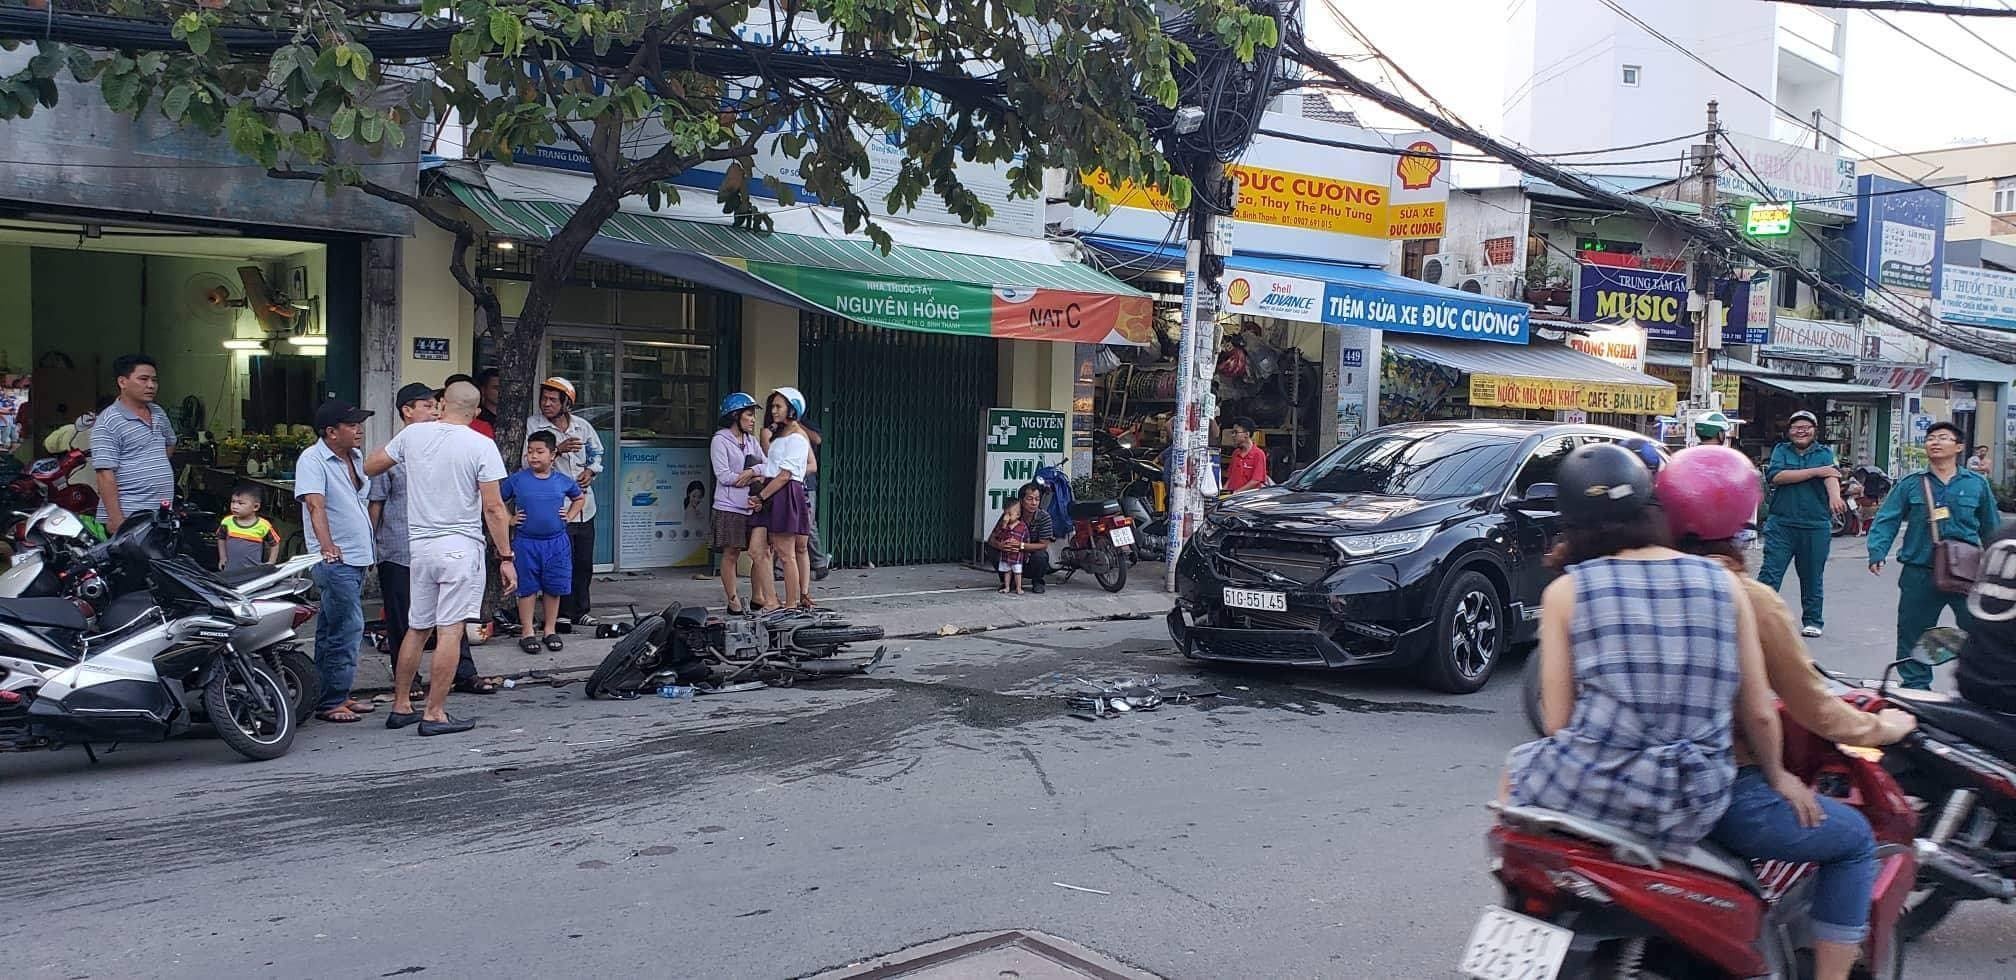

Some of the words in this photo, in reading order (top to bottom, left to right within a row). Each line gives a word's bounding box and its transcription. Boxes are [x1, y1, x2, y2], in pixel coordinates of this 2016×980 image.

[538, 150, 567, 161] TRANG
[1232, 169, 1285, 193] ĐỨC
[1292, 178, 1381, 206] CƯỜNG
[1261, 195, 1290, 212] Thay
[1295, 199, 1317, 214] Thế
[1320, 203, 1341, 220] Phụ
[1345, 207, 1373, 223] Tùng
[1400, 206, 1419, 219] SỬA
[1423, 207, 1435, 218] XE
[1839, 201, 1855, 213] CHIM
[1410, 219, 1442, 235] CƯỜNG
[1271, 282, 1292, 294] Shell
[1618, 275, 1650, 290] TRUNG
[836, 294, 908, 317] NGUYÊN
[913, 296, 960, 320] HỒNG
[1260, 293, 1315, 310] ADVANCE
[1596, 290, 1678, 323] MUSIC
[1030, 307, 1064, 329] NAT
[1066, 303, 1081, 329] C
[1329, 295, 1364, 322] TIỆM
[1368, 296, 1397, 323] SỬA
[1401, 305, 1419, 326] XE
[1422, 301, 1458, 330] ĐỨC
[1461, 306, 1520, 337] CƯỜNG
[1775, 323, 1794, 344] HIM
[1796, 328, 1828, 348] CẢNH
[1830, 331, 1850, 350] SƠN
[416, 340, 446, 350] 447
[1345, 351, 1361, 361] 449
[1497, 382, 1520, 403] NƯỚC
[1522, 384, 1538, 405] MÍA
[1539, 384, 1556, 406] GIẢI
[1558, 384, 1581, 406] KHÁT
[1614, 388, 1631, 409] BÁN
[1020, 414, 1064, 429] NGUYÊN
[1028, 432, 1059, 449] HỒNG
[623, 452, 657, 464] Hiruscar
